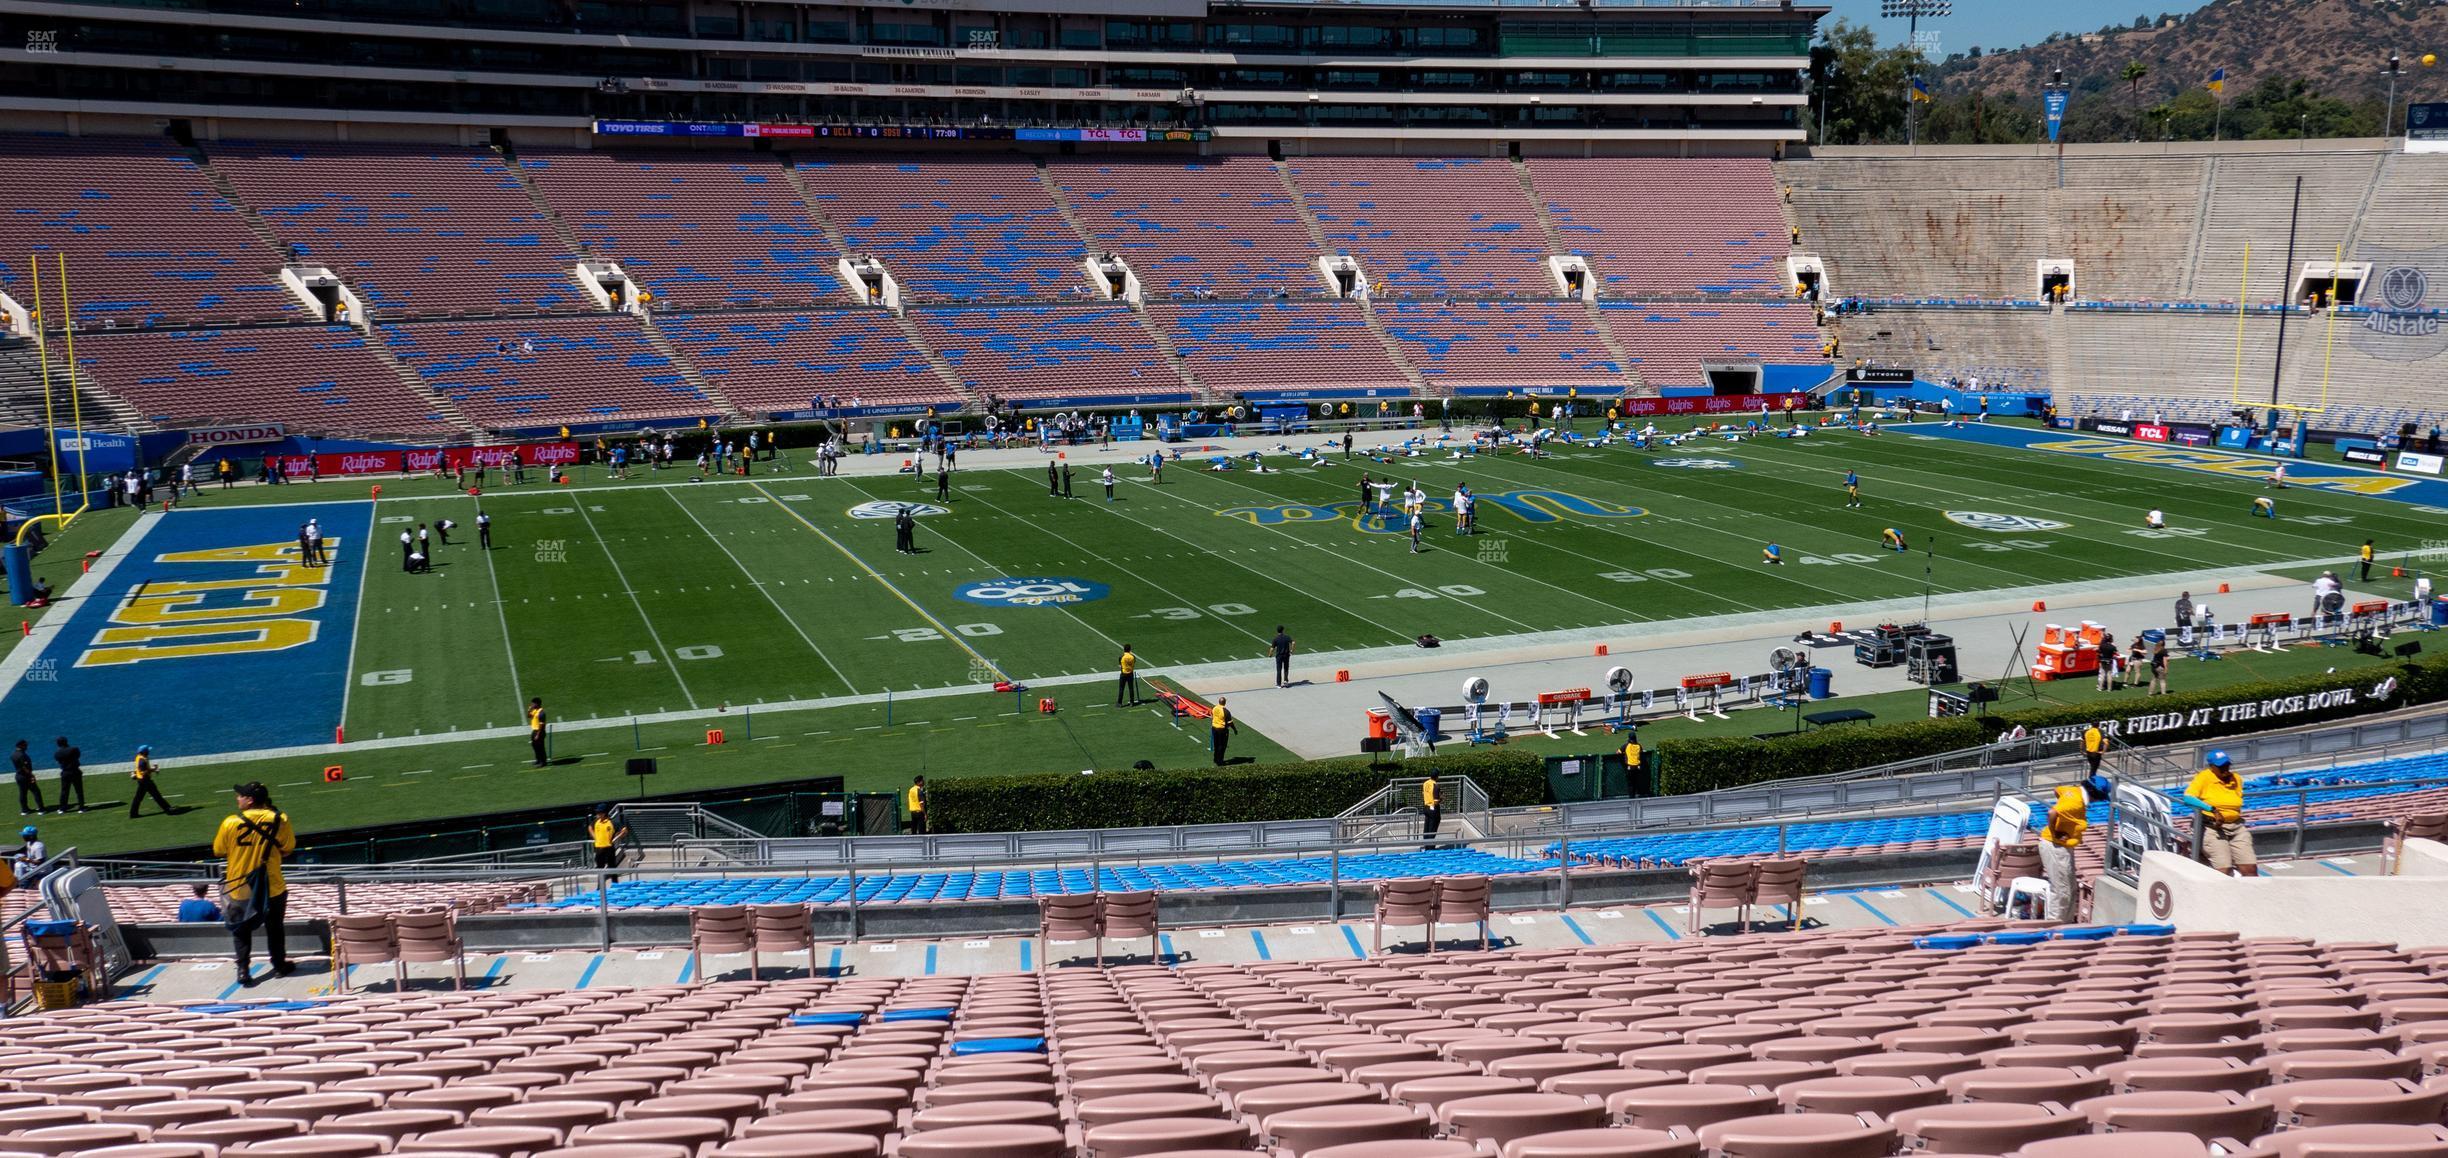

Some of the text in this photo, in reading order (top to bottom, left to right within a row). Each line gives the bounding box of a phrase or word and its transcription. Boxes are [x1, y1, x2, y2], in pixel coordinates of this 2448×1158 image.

[605, 124, 664, 133] TOYO TIRES
[1088, 129, 1110, 139] TCL
[1119, 130, 1141, 139] TCL
[2362, 311, 2437, 335] Allstate
[1629, 400, 1656, 414] Ralphs
[1668, 398, 1694, 413] Ralphs
[1705, 397, 1731, 411] Ralphs
[1779, 394, 1804, 406] Rahs
[871, 406, 898, 415] UNDER
[190, 427, 281, 443] HONDA
[2097, 424, 2128, 434] NISSAN
[2139, 427, 2163, 439] TCL
[93, 439, 126, 448] Health
[533, 446, 576, 464] Ralphs
[342, 455, 386, 472] Ralphs
[2026, 440, 2422, 494] UCLA
[1597, 568, 1694, 583] 50
[1395, 583, 1487, 600] 40
[72, 537, 342, 669] UCLA
[1151, 602, 1259, 620] 30
[891, 622, 1004, 642] 20
[628, 644, 725, 665] 10
[1596, 645, 1608, 656] 40
[2044, 655, 2053, 666] G
[2064, 653, 2076, 668] G
[361, 668, 413, 686] G
[1337, 670, 1350, 682] 30
[1553, 692, 1582, 701] GATORADE
[2040, 688, 2356, 744] SPIEER FIELD AT THE ROSE BOWL
[1382, 719, 1395, 733] G
[708, 731, 722, 745] 10
[328, 767, 342, 781] G
[2155, 888, 2166, 910] 3
